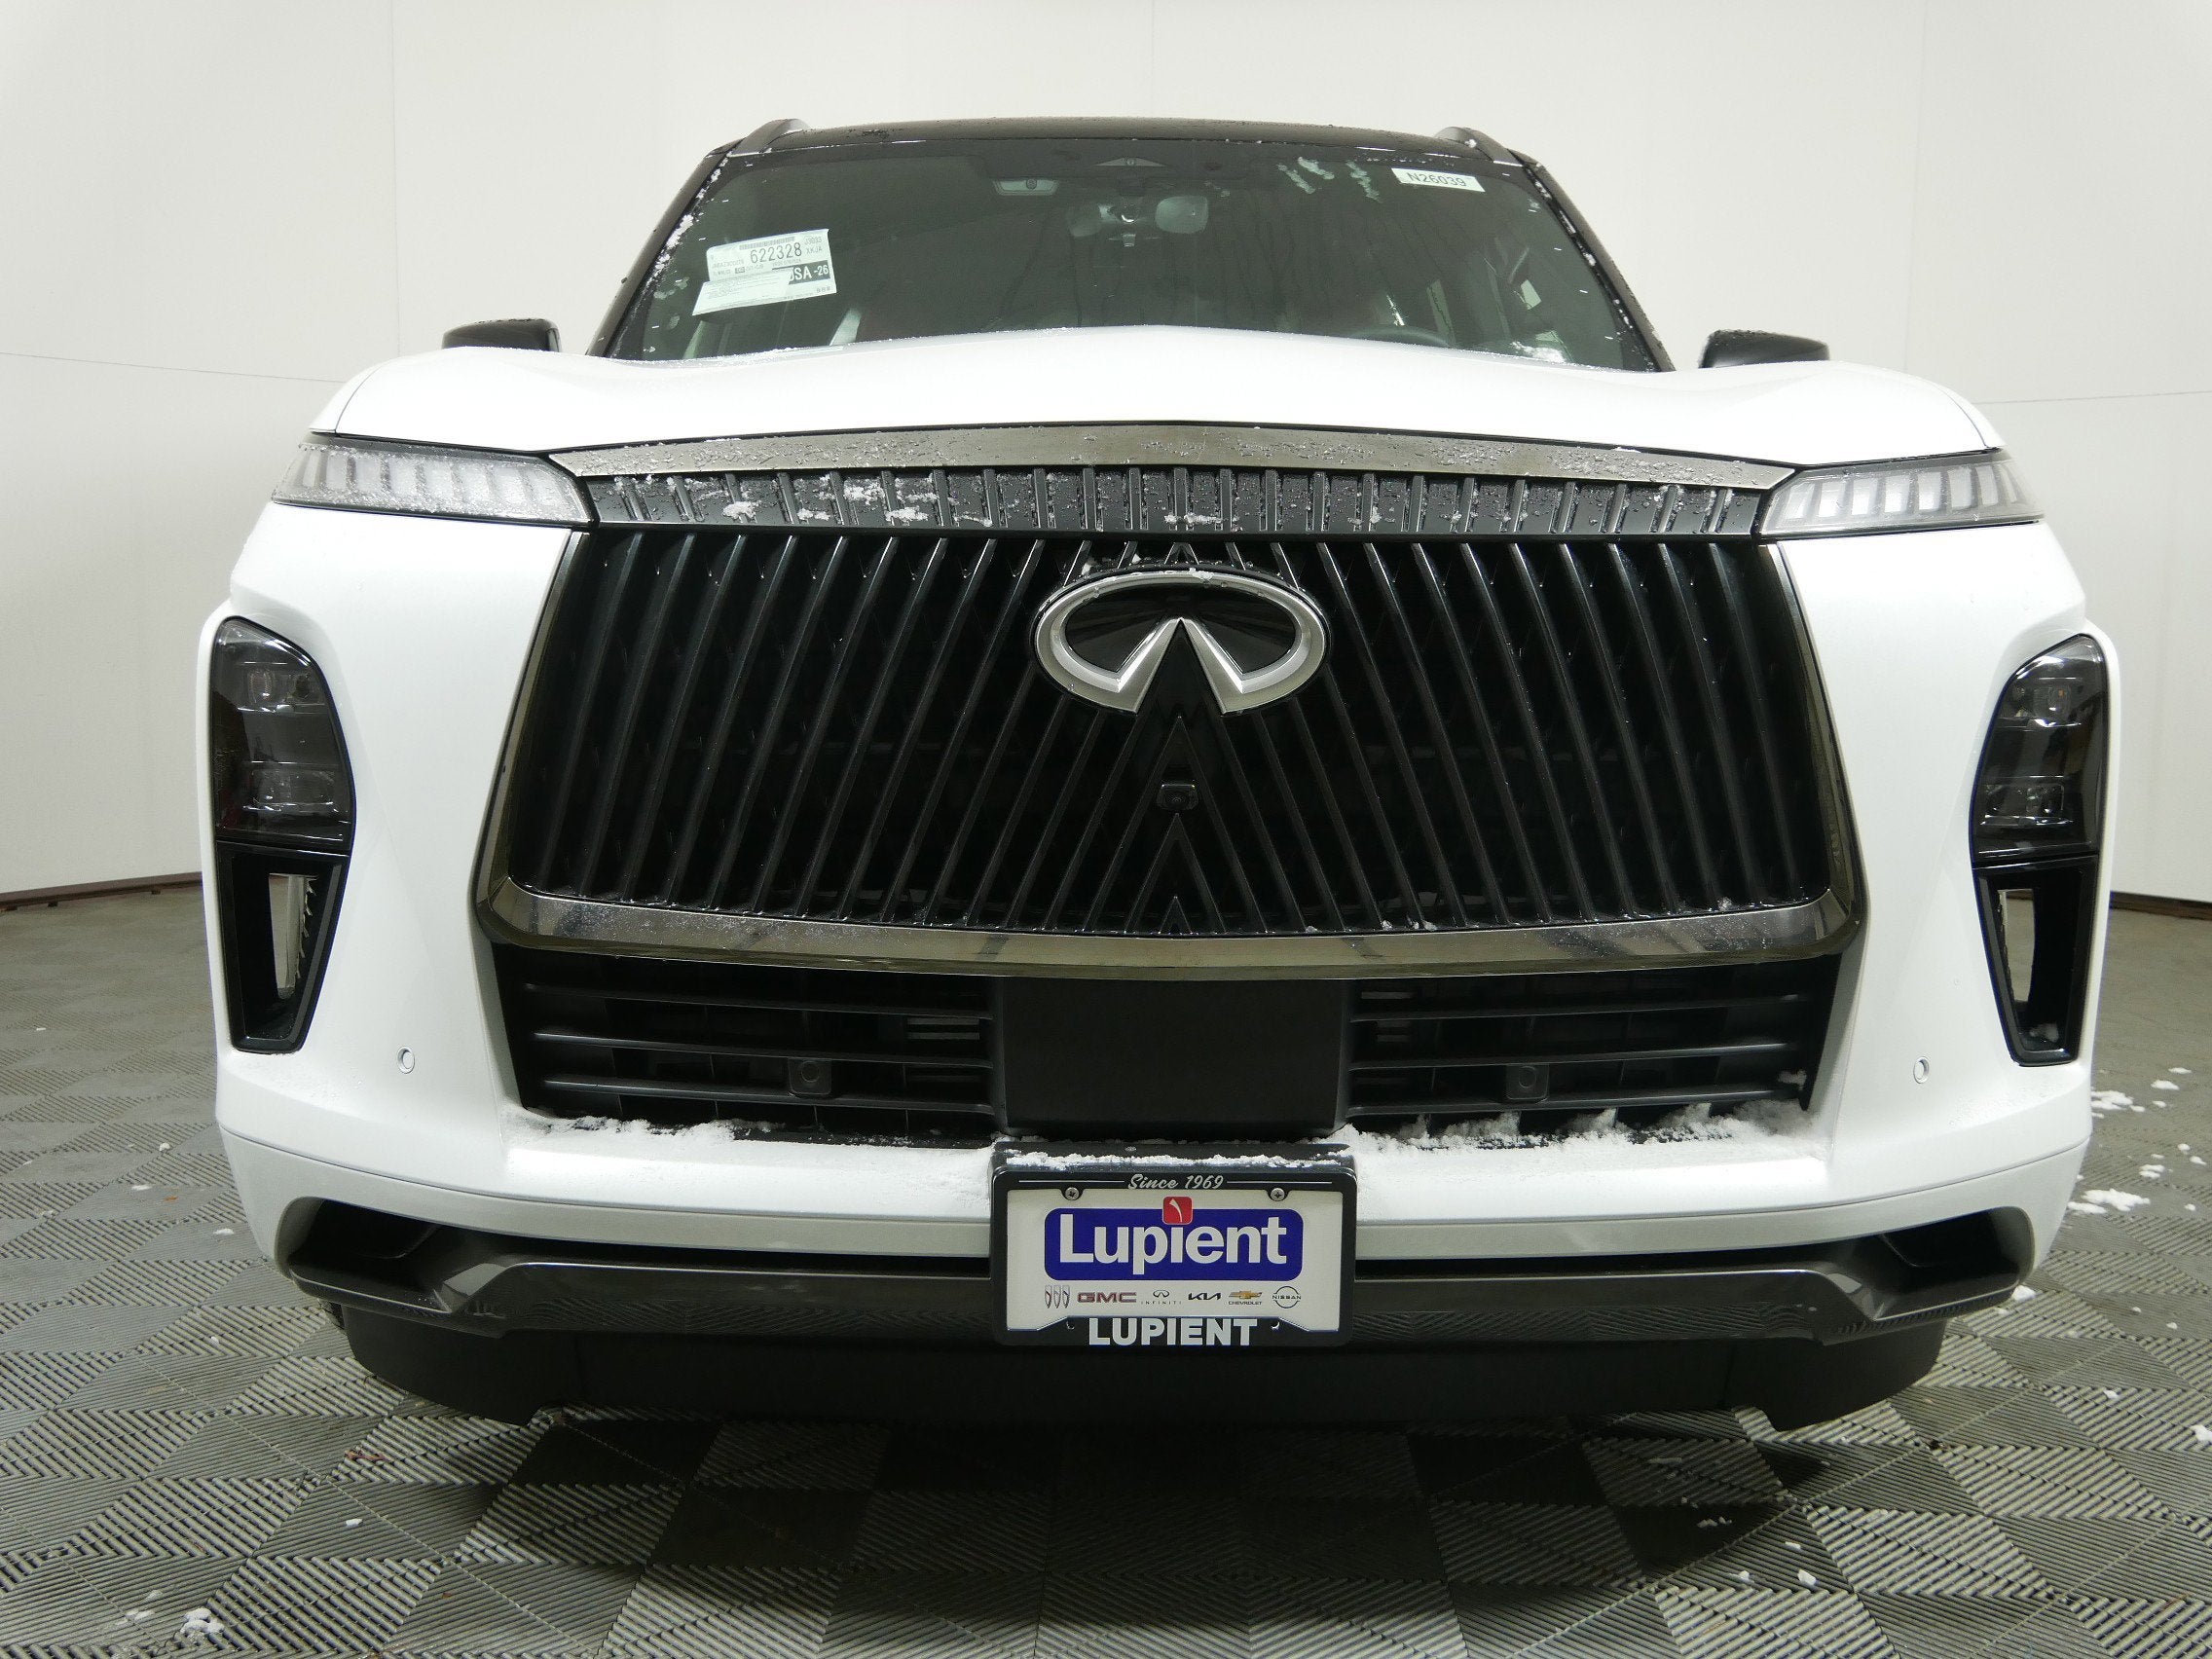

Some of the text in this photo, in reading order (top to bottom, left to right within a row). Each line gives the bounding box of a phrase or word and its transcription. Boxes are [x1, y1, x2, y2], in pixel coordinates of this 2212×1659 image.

[1407, 172, 1467, 187] N26039
[750, 242, 802, 264] 622328
[1127, 1174, 1224, 1190] Since 1969
[1060, 1214, 1287, 1275] Lupient
[1077, 1291, 1137, 1304] GMC
[1088, 1317, 1257, 1346] LUPIENT
